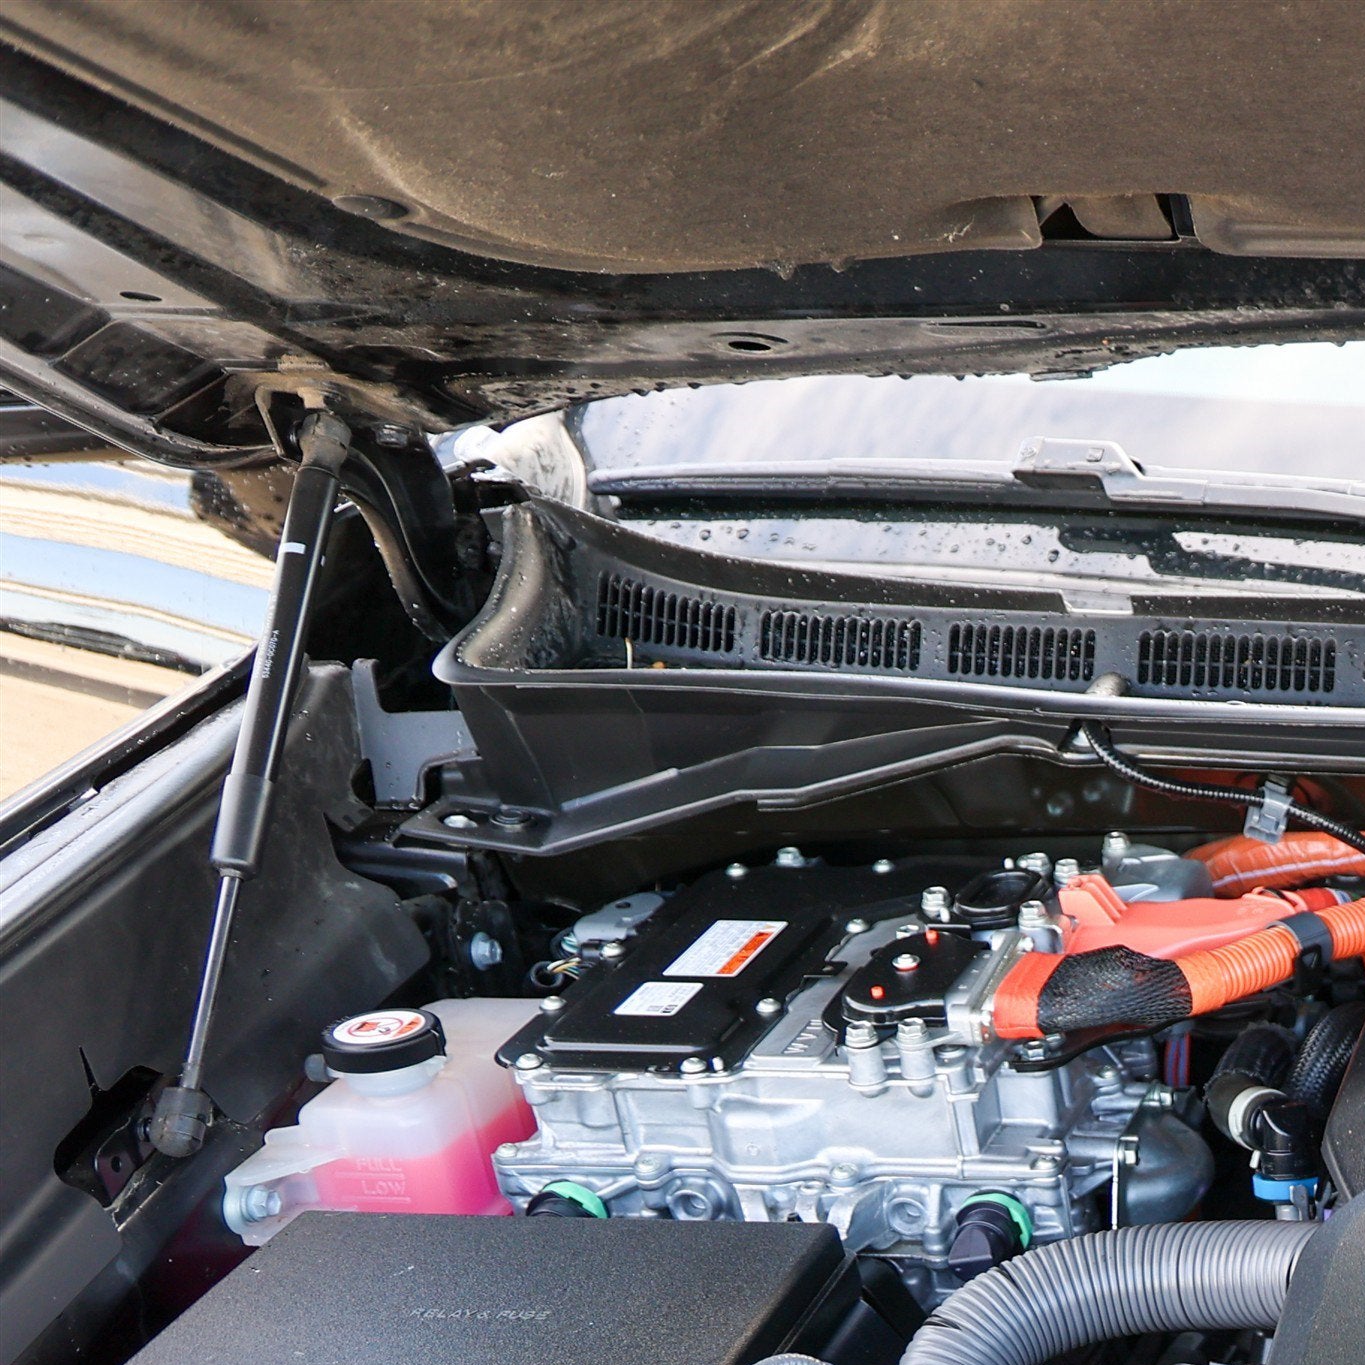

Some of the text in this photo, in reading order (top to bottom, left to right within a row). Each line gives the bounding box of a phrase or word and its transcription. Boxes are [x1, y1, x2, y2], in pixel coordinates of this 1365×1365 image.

[356, 1156, 402, 1172] FULL
[361, 1180, 406, 1195] LOW
[410, 1307, 477, 1320] RELAY
[496, 1309, 553, 1321] FUSE
